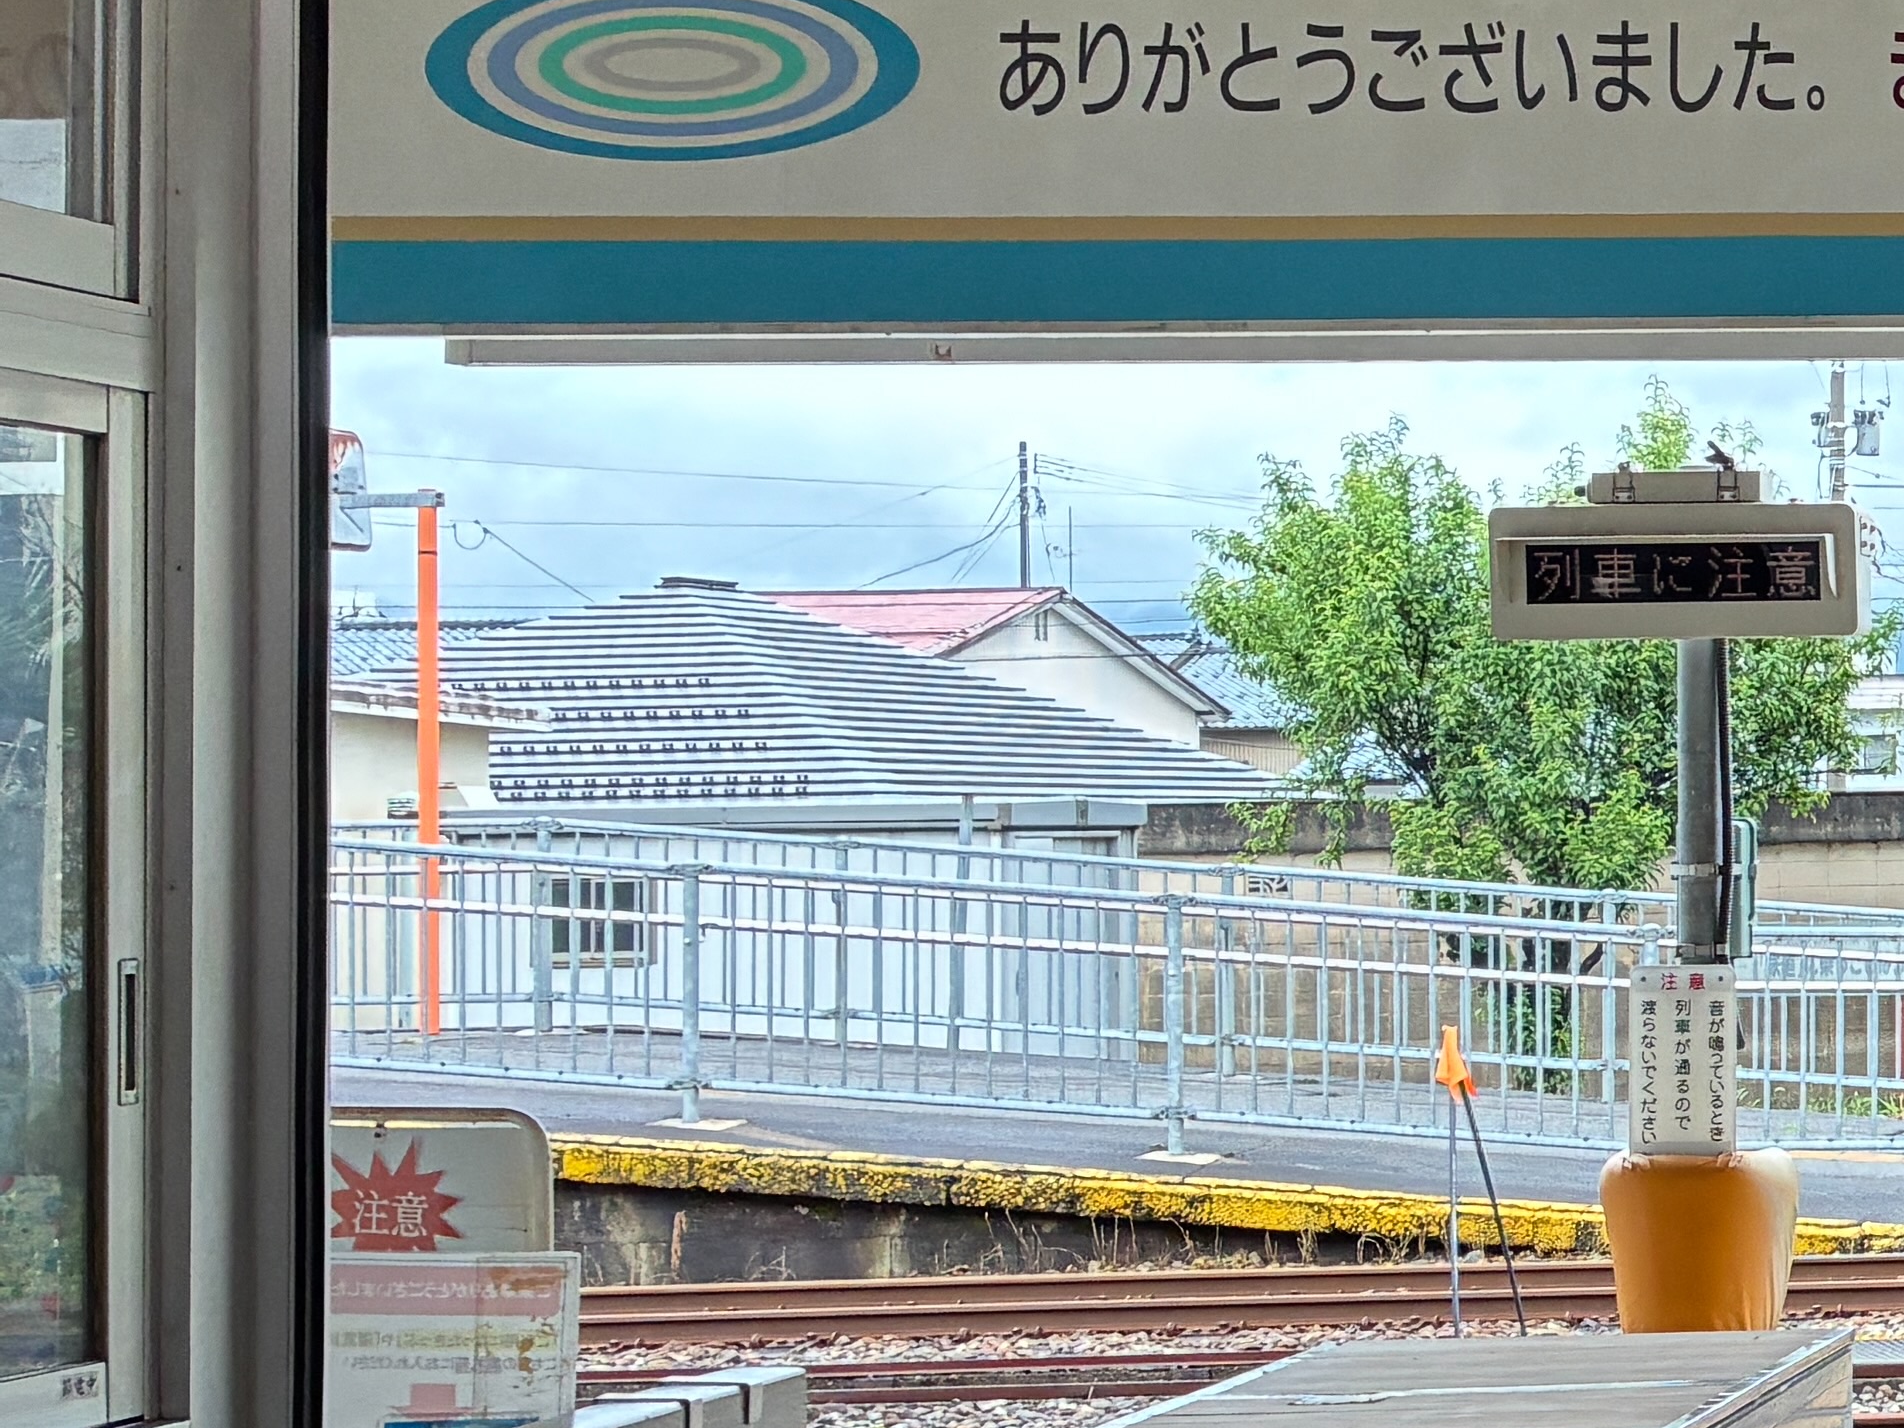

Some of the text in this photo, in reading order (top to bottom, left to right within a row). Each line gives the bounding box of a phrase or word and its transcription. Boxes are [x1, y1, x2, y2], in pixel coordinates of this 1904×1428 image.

[1000, 21, 1826, 115] ありがとうございました。
[1534, 544, 1817, 601] 列車に注意
[1661, 973, 1705, 990] 注意
[1640, 1000, 1657, 1144] 渡らないでください
[1674, 999, 1691, 1130] 列車が通るので
[1708, 1000, 1725, 1142] 音が鳴っているとき
[353, 1190, 428, 1237] 注意
